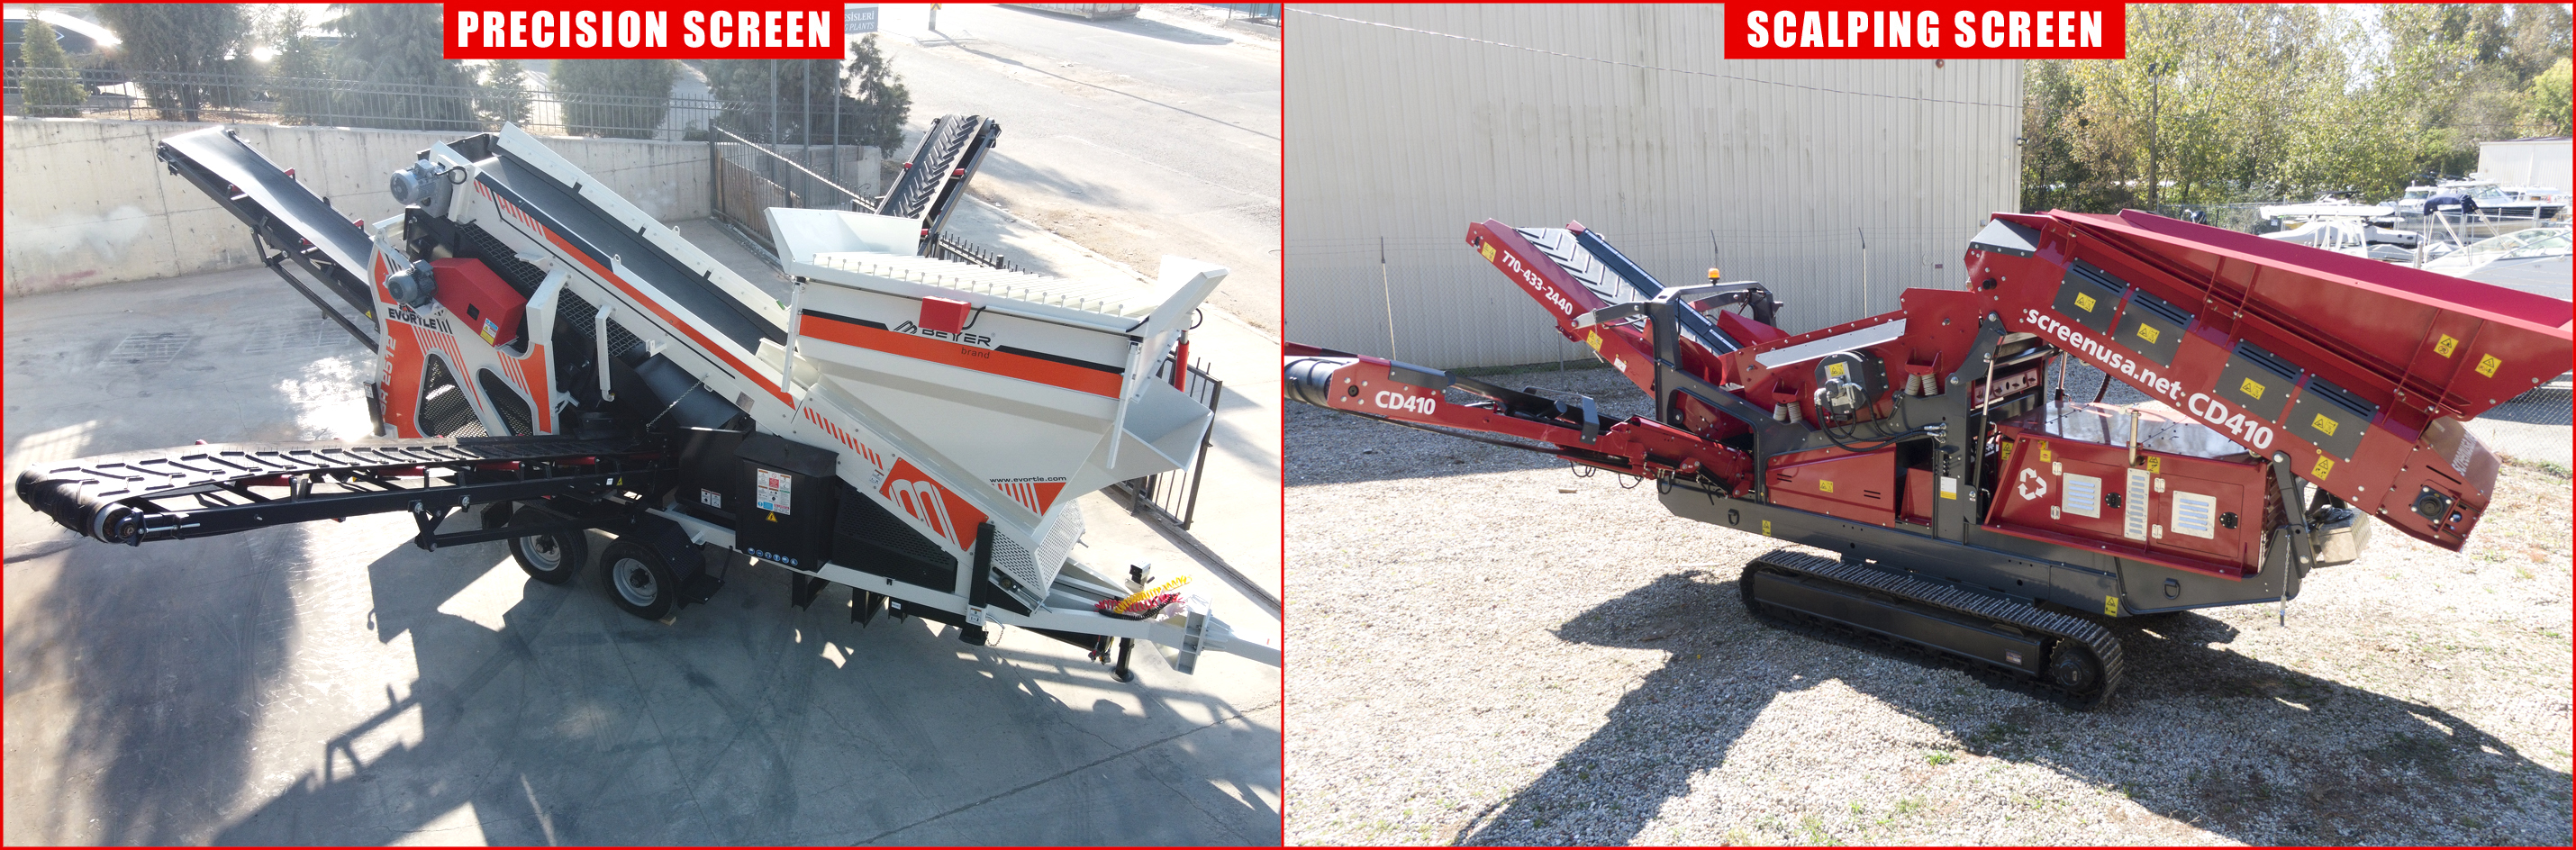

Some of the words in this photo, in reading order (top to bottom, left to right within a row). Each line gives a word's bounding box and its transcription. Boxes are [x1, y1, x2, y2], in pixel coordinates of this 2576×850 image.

[1501, 250, 1574, 316] 770-433-2440
[388, 307, 437, 330] EVORTLE
[382, 335, 396, 387] 2512
[960, 347, 991, 359] brand
[2026, 308, 2184, 401] screenusa.net
[2187, 392, 2274, 450] CD410
[1374, 390, 1437, 415] CD410
